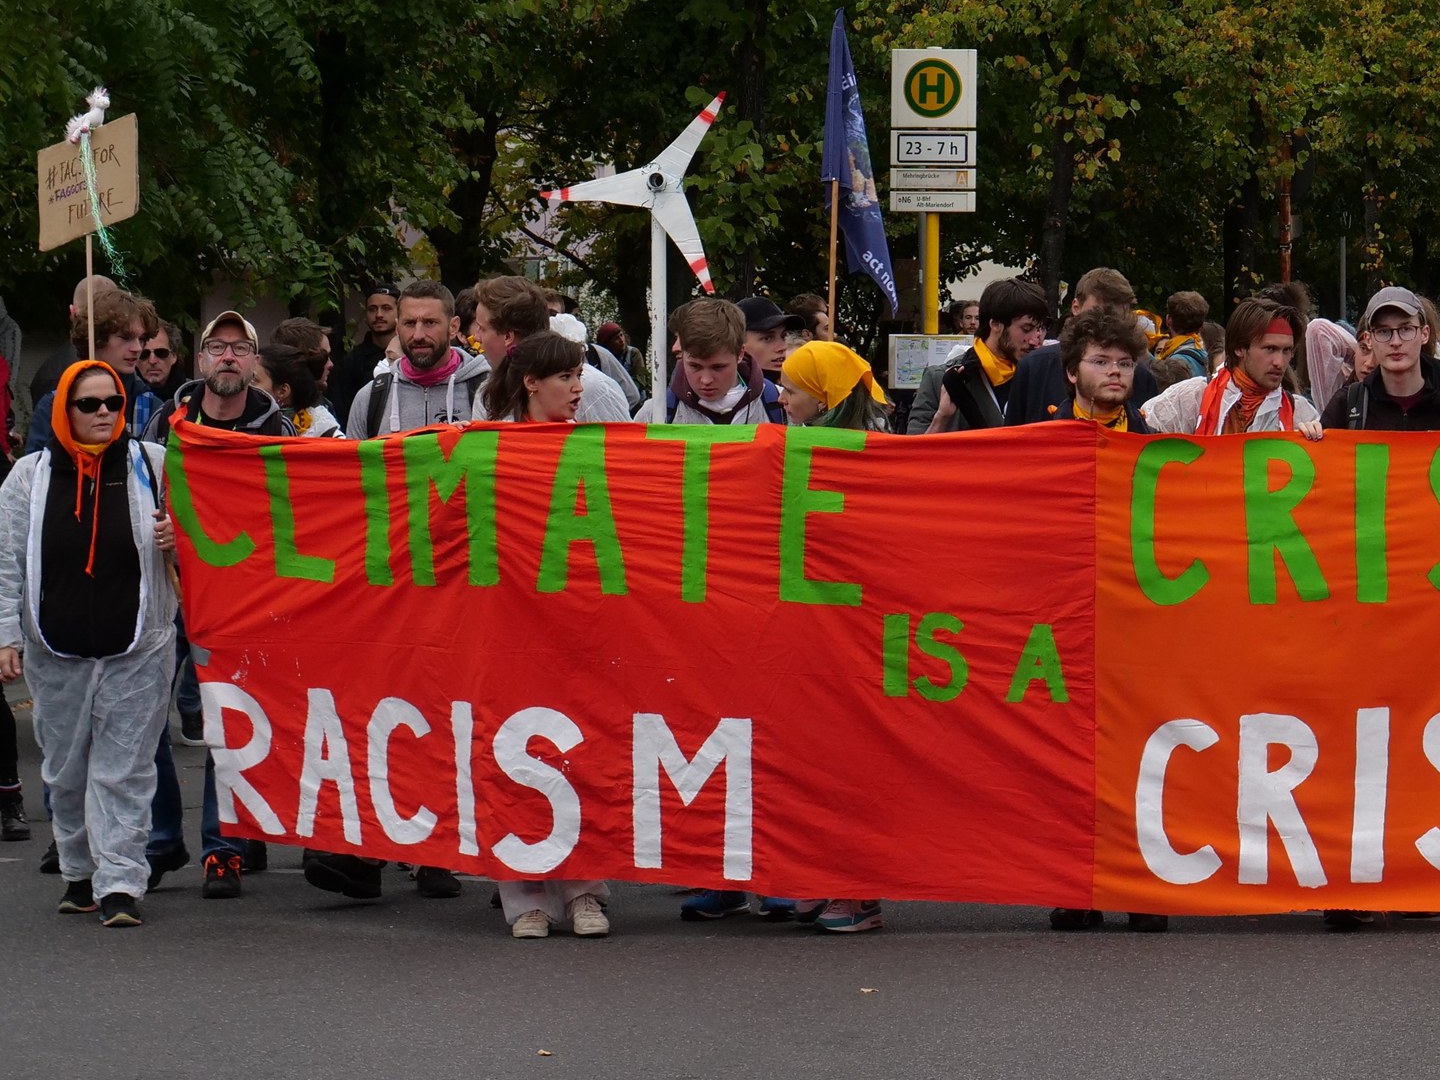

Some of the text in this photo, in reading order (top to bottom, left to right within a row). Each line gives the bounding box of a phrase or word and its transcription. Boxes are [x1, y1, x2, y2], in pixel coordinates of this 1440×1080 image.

[906, 142, 922, 155] 23
[937, 142, 945, 155] 7
[950, 142, 958, 155] h
[862, 250, 884, 275] act
[165, 423, 868, 606] CLIMATE
[881, 612, 1069, 703] IS A
[199, 681, 753, 881] RACISM
